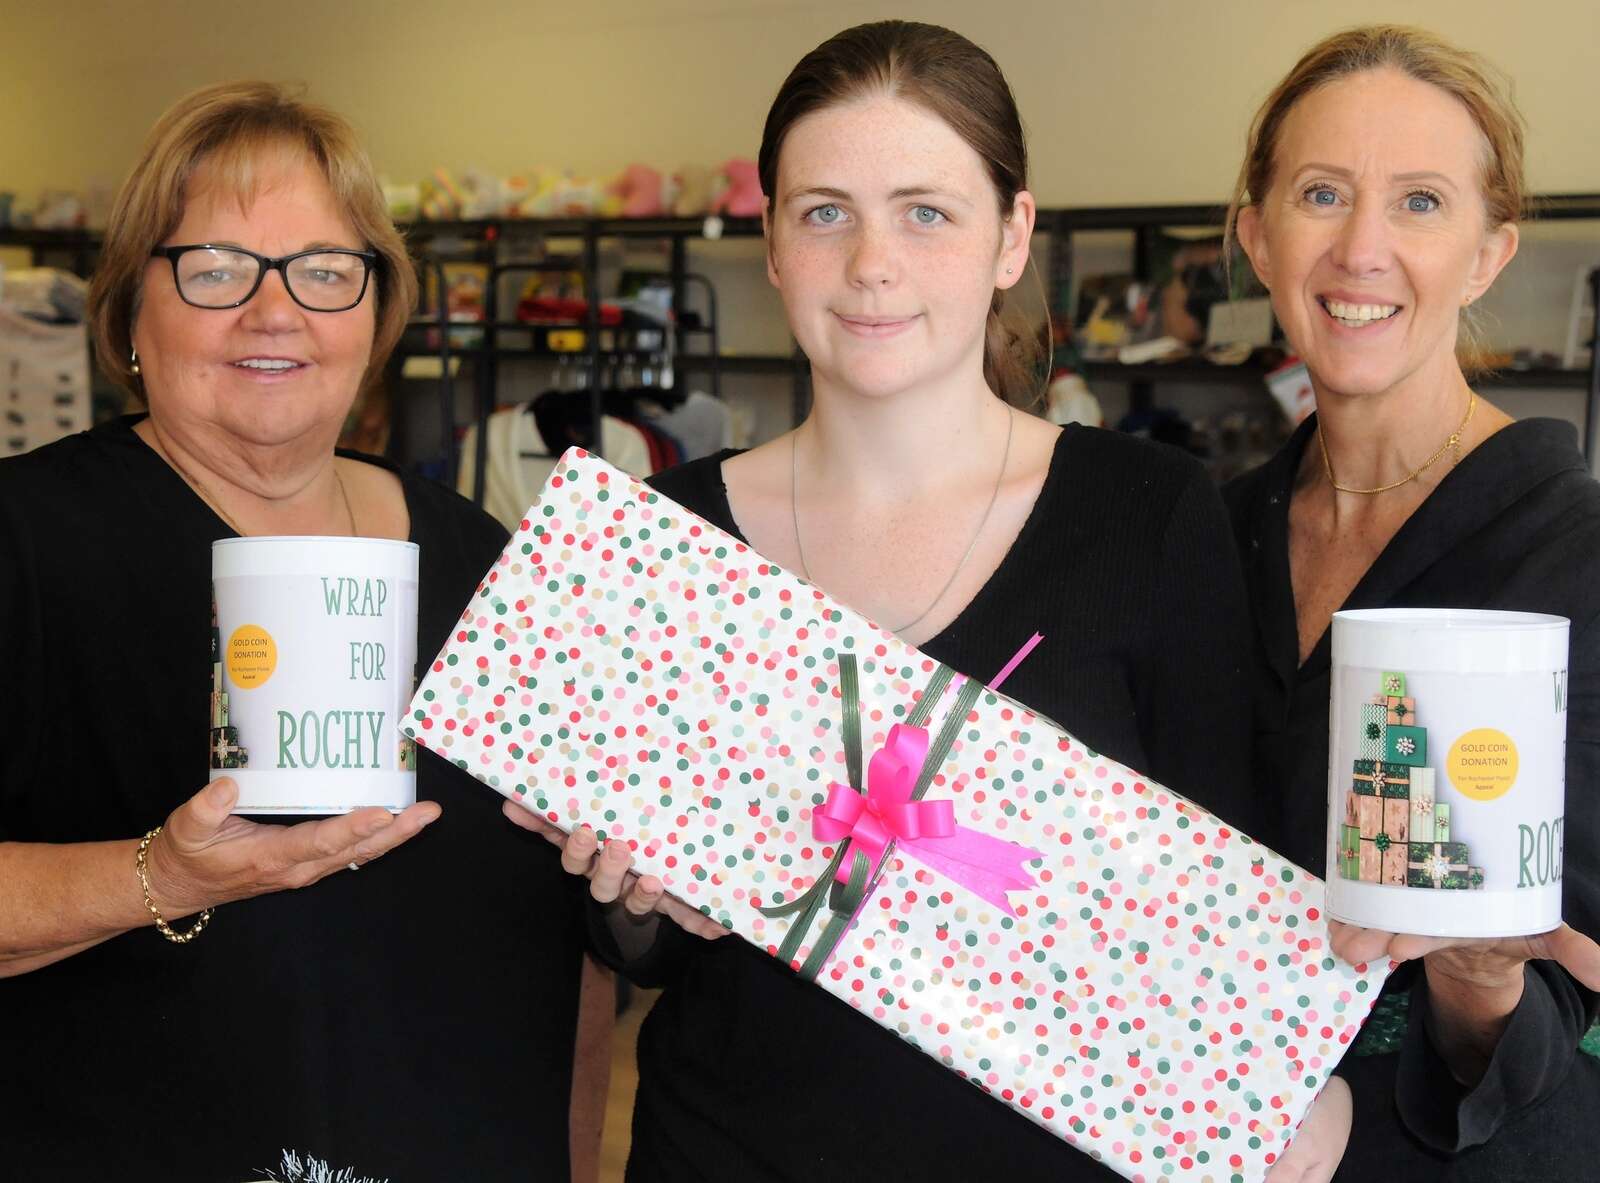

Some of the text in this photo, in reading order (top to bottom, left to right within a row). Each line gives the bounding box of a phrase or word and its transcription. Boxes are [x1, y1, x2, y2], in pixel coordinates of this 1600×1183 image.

[321, 577, 387, 617] WRAP
[233, 638, 268, 647] GOLD COIN
[233, 650, 267, 659] DONATION
[349, 641, 387, 681] FOR
[277, 709, 386, 769] ROCHY
[1460, 743, 1509, 752] GOLD COIN
[1461, 757, 1508, 766] DONATION
